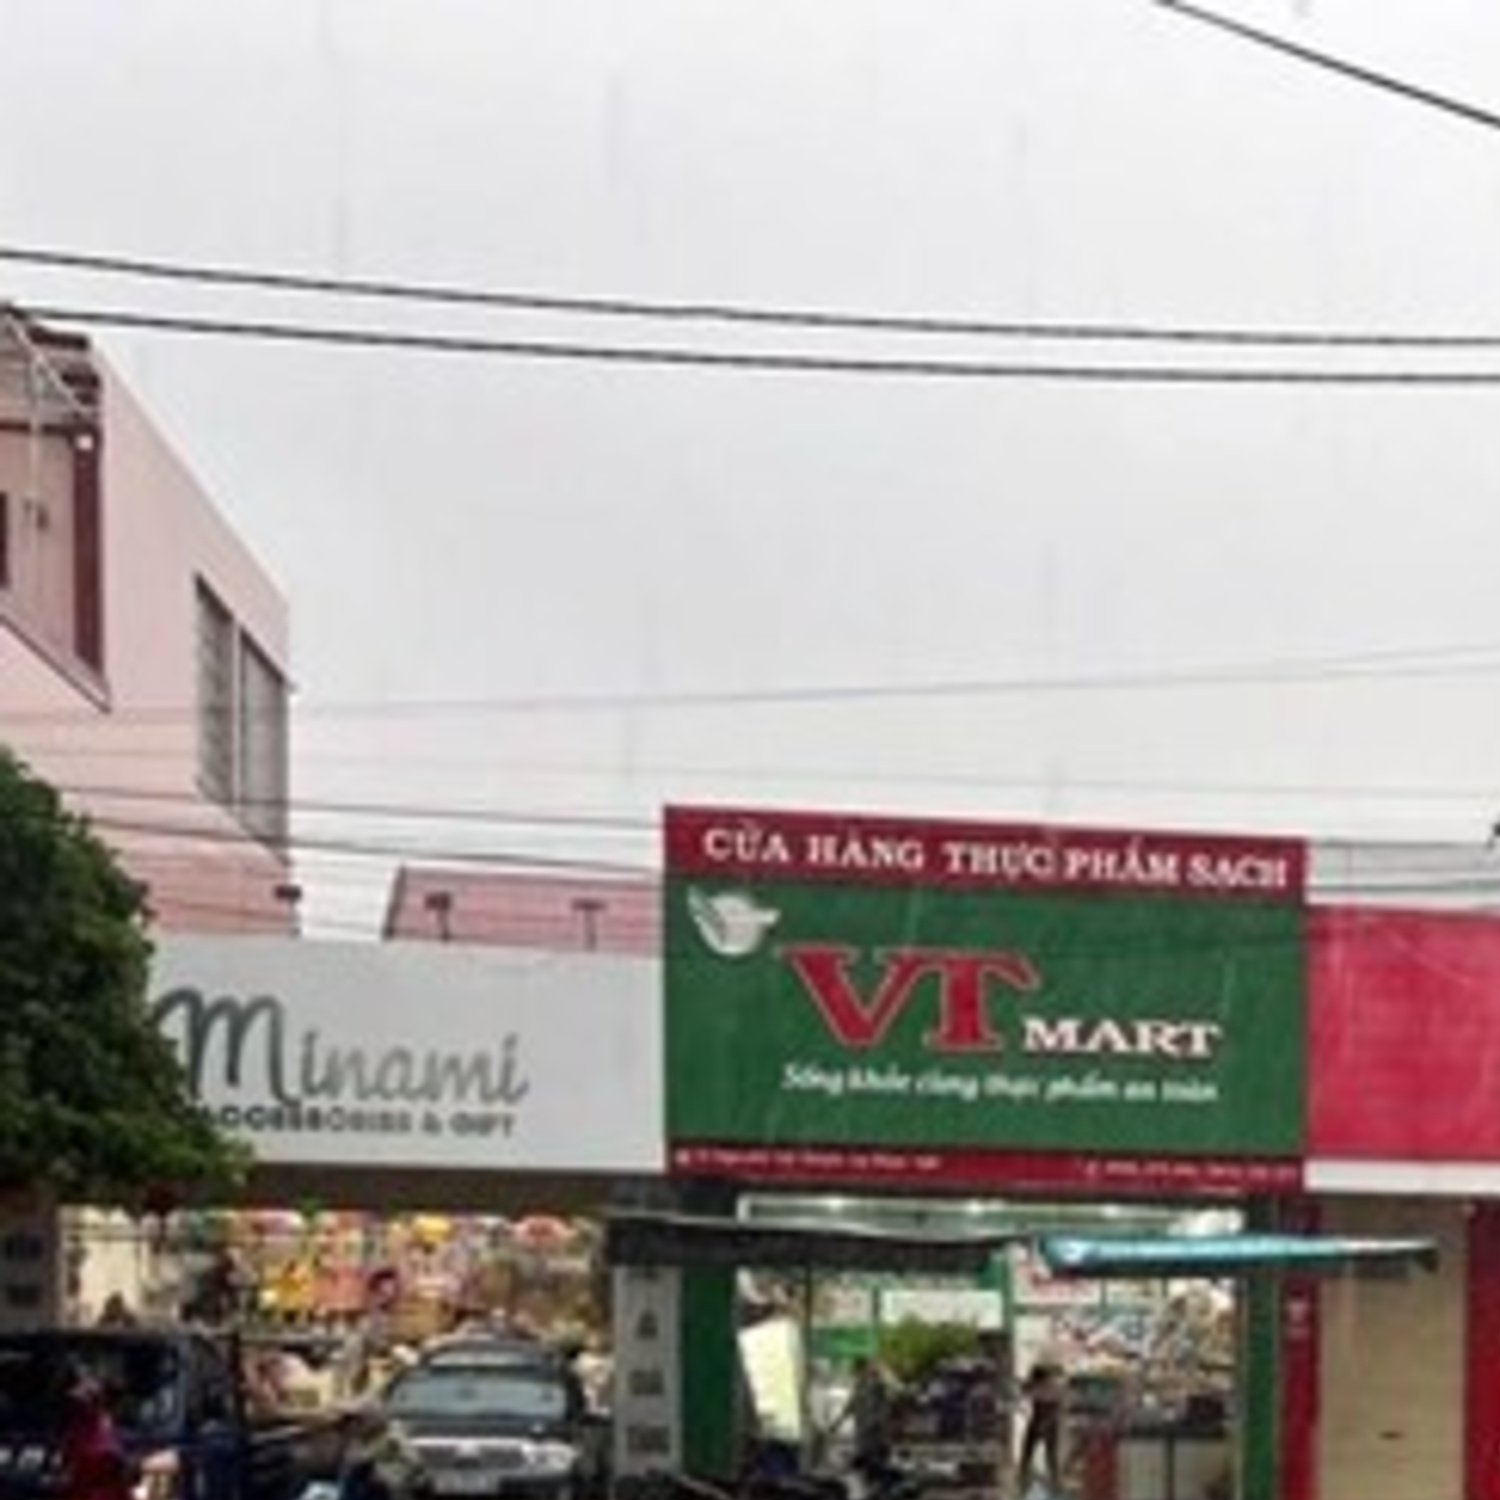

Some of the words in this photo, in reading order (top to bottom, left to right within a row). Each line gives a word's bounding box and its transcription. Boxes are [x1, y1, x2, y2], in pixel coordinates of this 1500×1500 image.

[156, 987, 530, 1106] Minami
[783, 943, 1039, 1051] VT
[1022, 1016, 1222, 1058] MART
